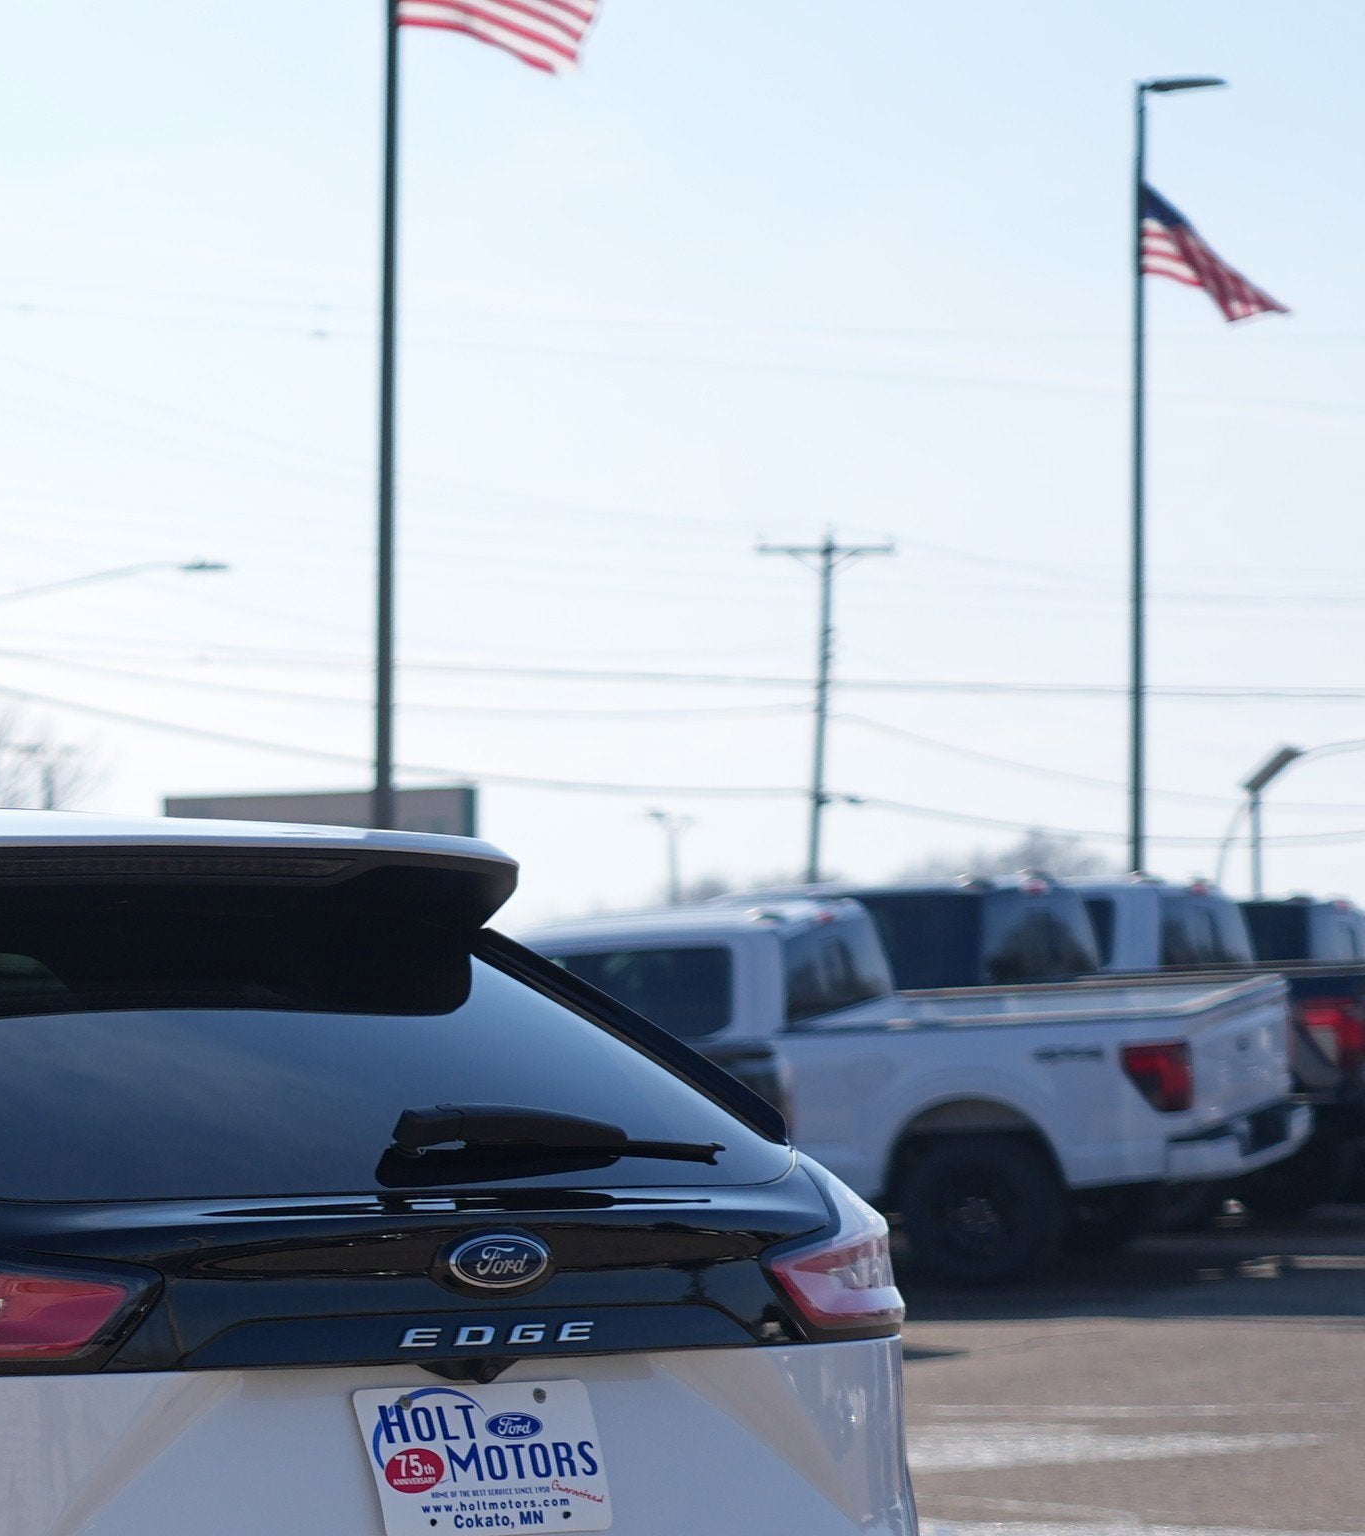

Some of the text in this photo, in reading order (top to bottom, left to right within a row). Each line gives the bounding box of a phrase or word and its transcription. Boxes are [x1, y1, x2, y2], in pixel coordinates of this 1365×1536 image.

[476, 1245, 529, 1276] Ford
[398, 1321, 594, 1348] EDGE
[377, 1404, 477, 1444] HOLT
[496, 1415, 533, 1437] Ford
[394, 1453, 436, 1478] 75th
[445, 1440, 599, 1483] MOTORS
[393, 1476, 437, 1487] ANNIVERSARY
[430, 1491, 449, 1499] HOME
[459, 1489, 471, 1498] THE
[472, 1488, 487, 1497] BEST
[487, 1487, 514, 1496] SERVICE
[514, 1486, 534, 1495] SINCE
[551, 1479, 605, 1504] Guaranteed
[421, 1498, 571, 1514] www.holtmotors.com
[453, 1510, 544, 1529] Cokato, MN
